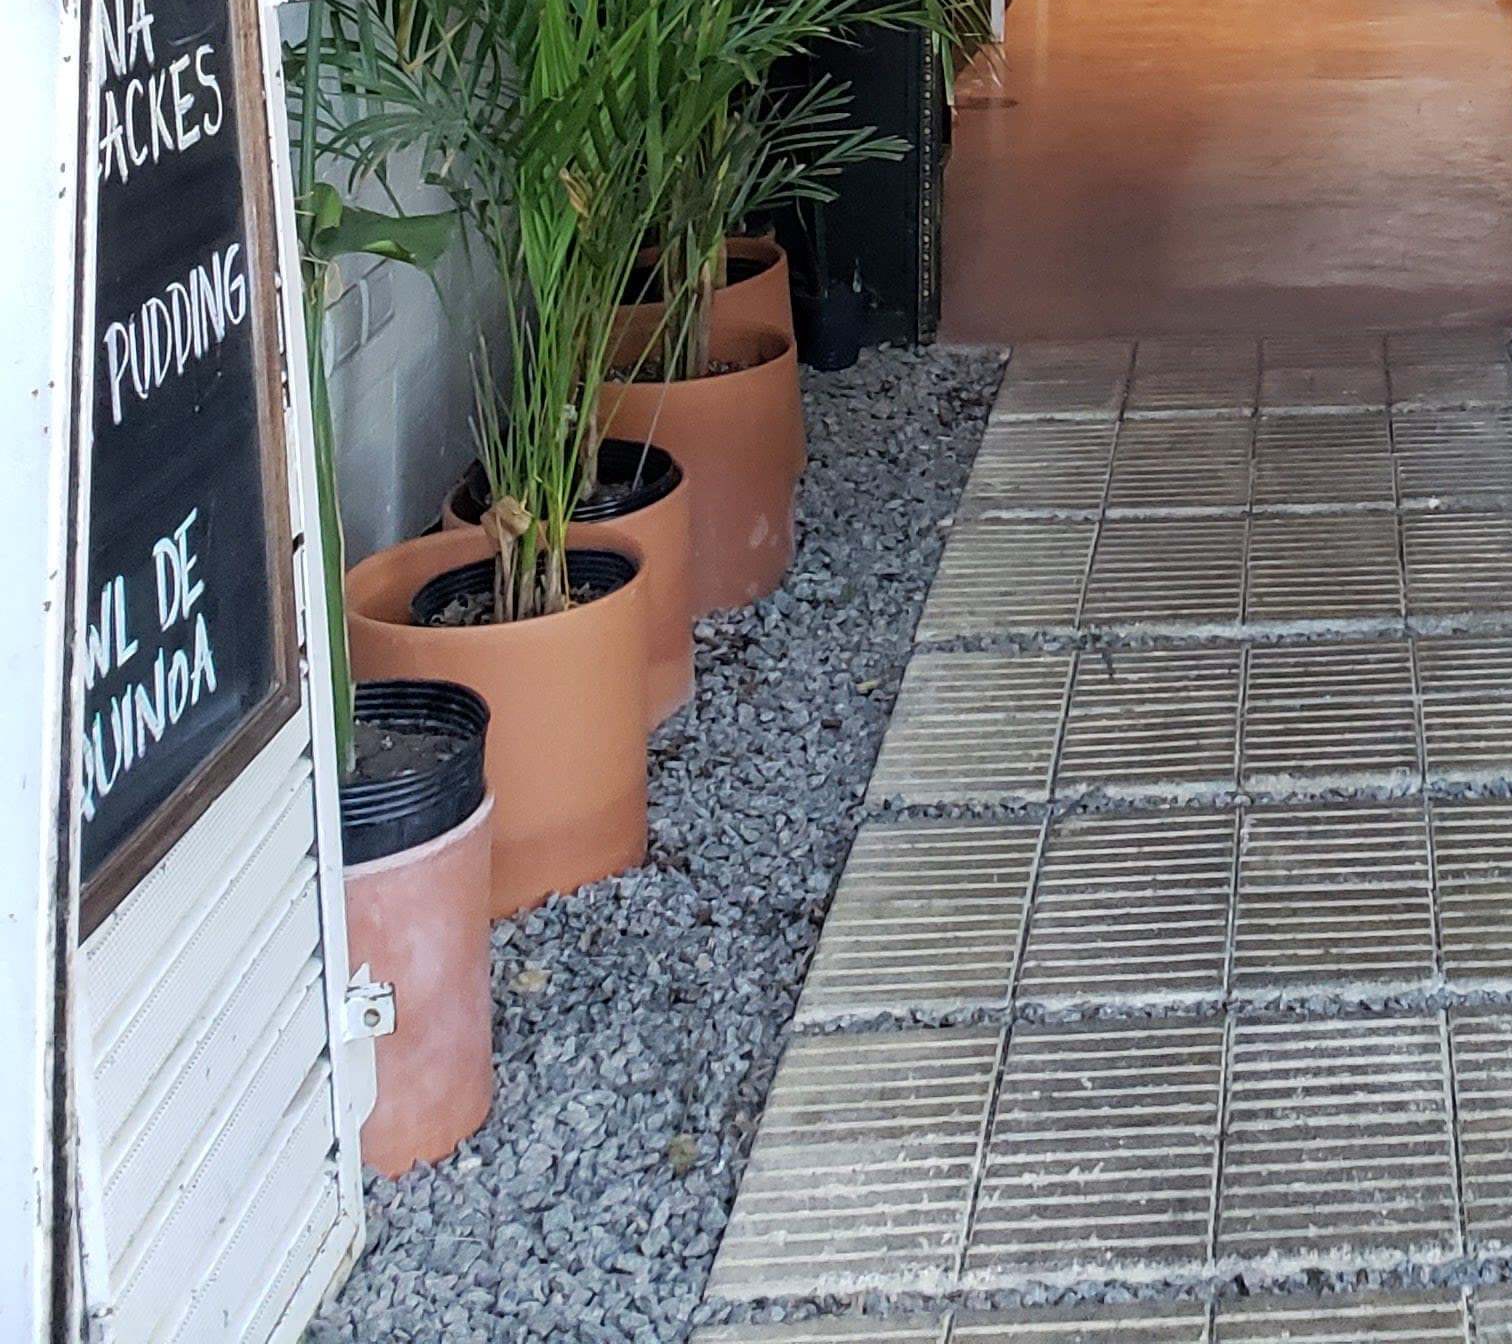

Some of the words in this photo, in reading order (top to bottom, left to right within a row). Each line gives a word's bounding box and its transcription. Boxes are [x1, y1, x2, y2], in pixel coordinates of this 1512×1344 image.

[98, 44, 223, 185] ACKES
[103, 242, 246, 425] PUDDING
[152, 507, 205, 632] DE
